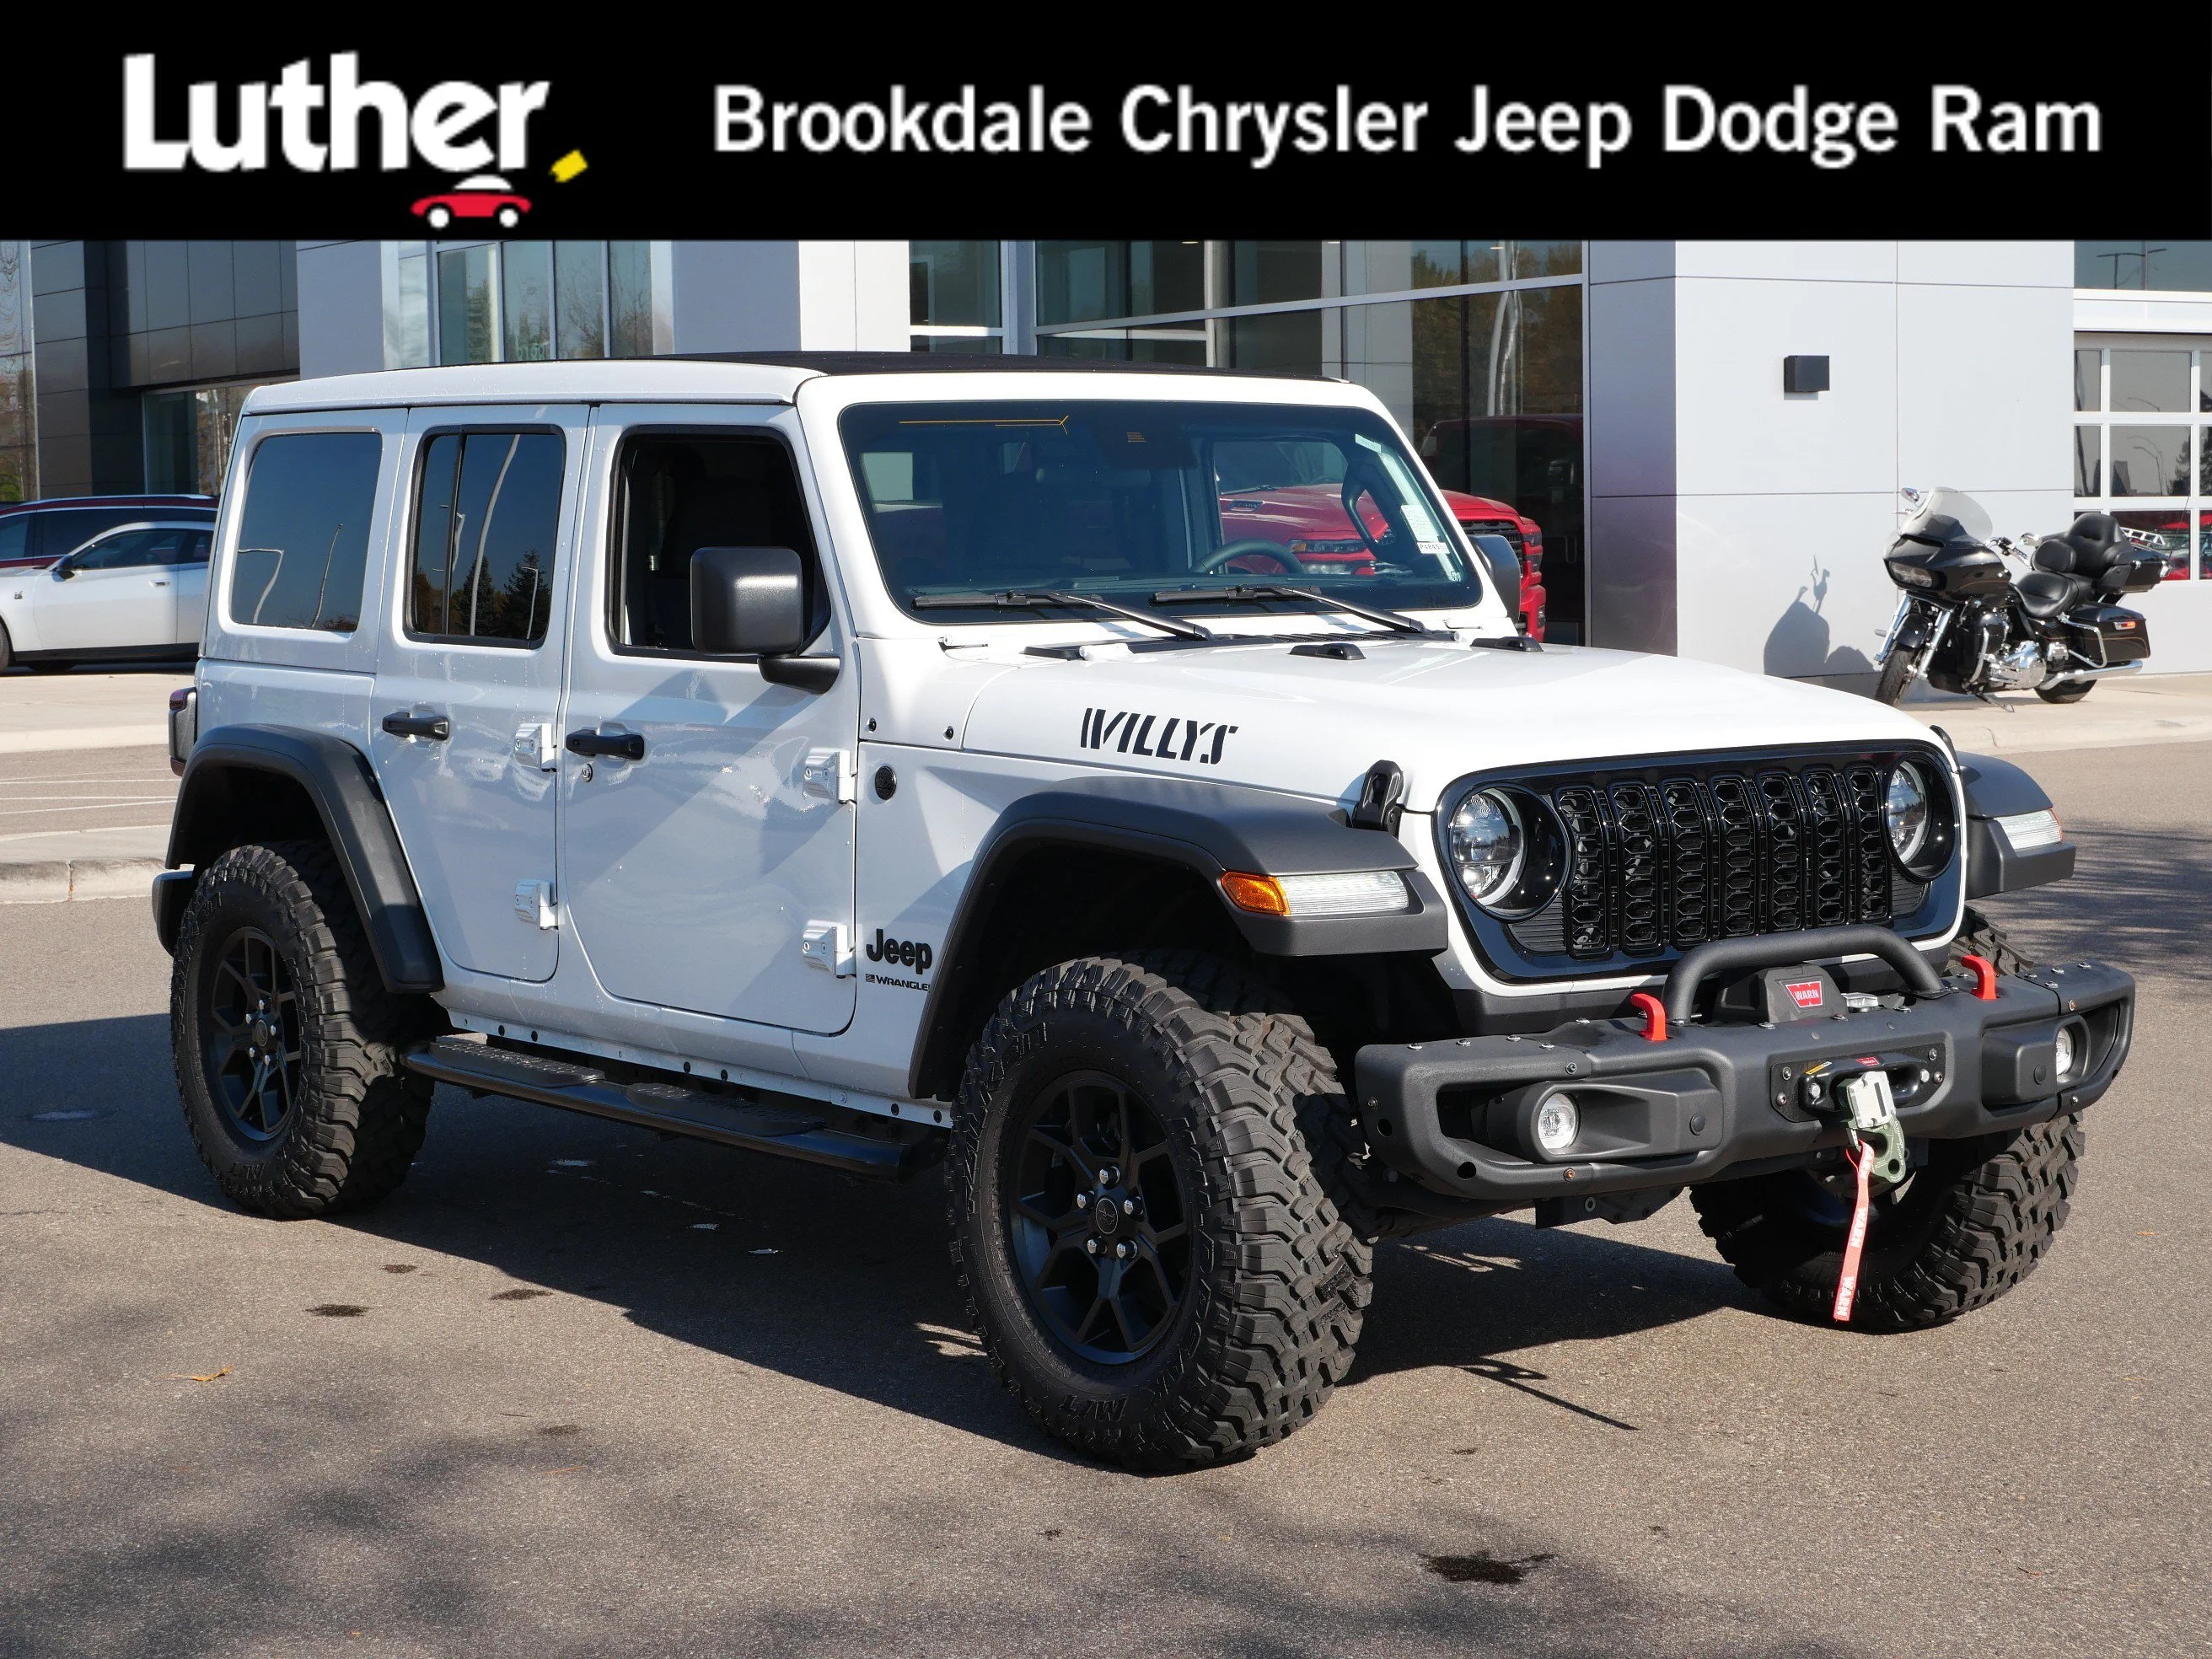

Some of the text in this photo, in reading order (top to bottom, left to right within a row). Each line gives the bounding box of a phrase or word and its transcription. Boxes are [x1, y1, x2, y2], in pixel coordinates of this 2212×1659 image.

[1080, 707, 1239, 765] WILLYS
[866, 928, 932, 974] Jeep
[875, 974, 931, 991] WRANGLE
[1795, 989, 1819, 1001] WARN
[1850, 1206, 1867, 1248] WARN
[1837, 1275, 1855, 1317] WARN
